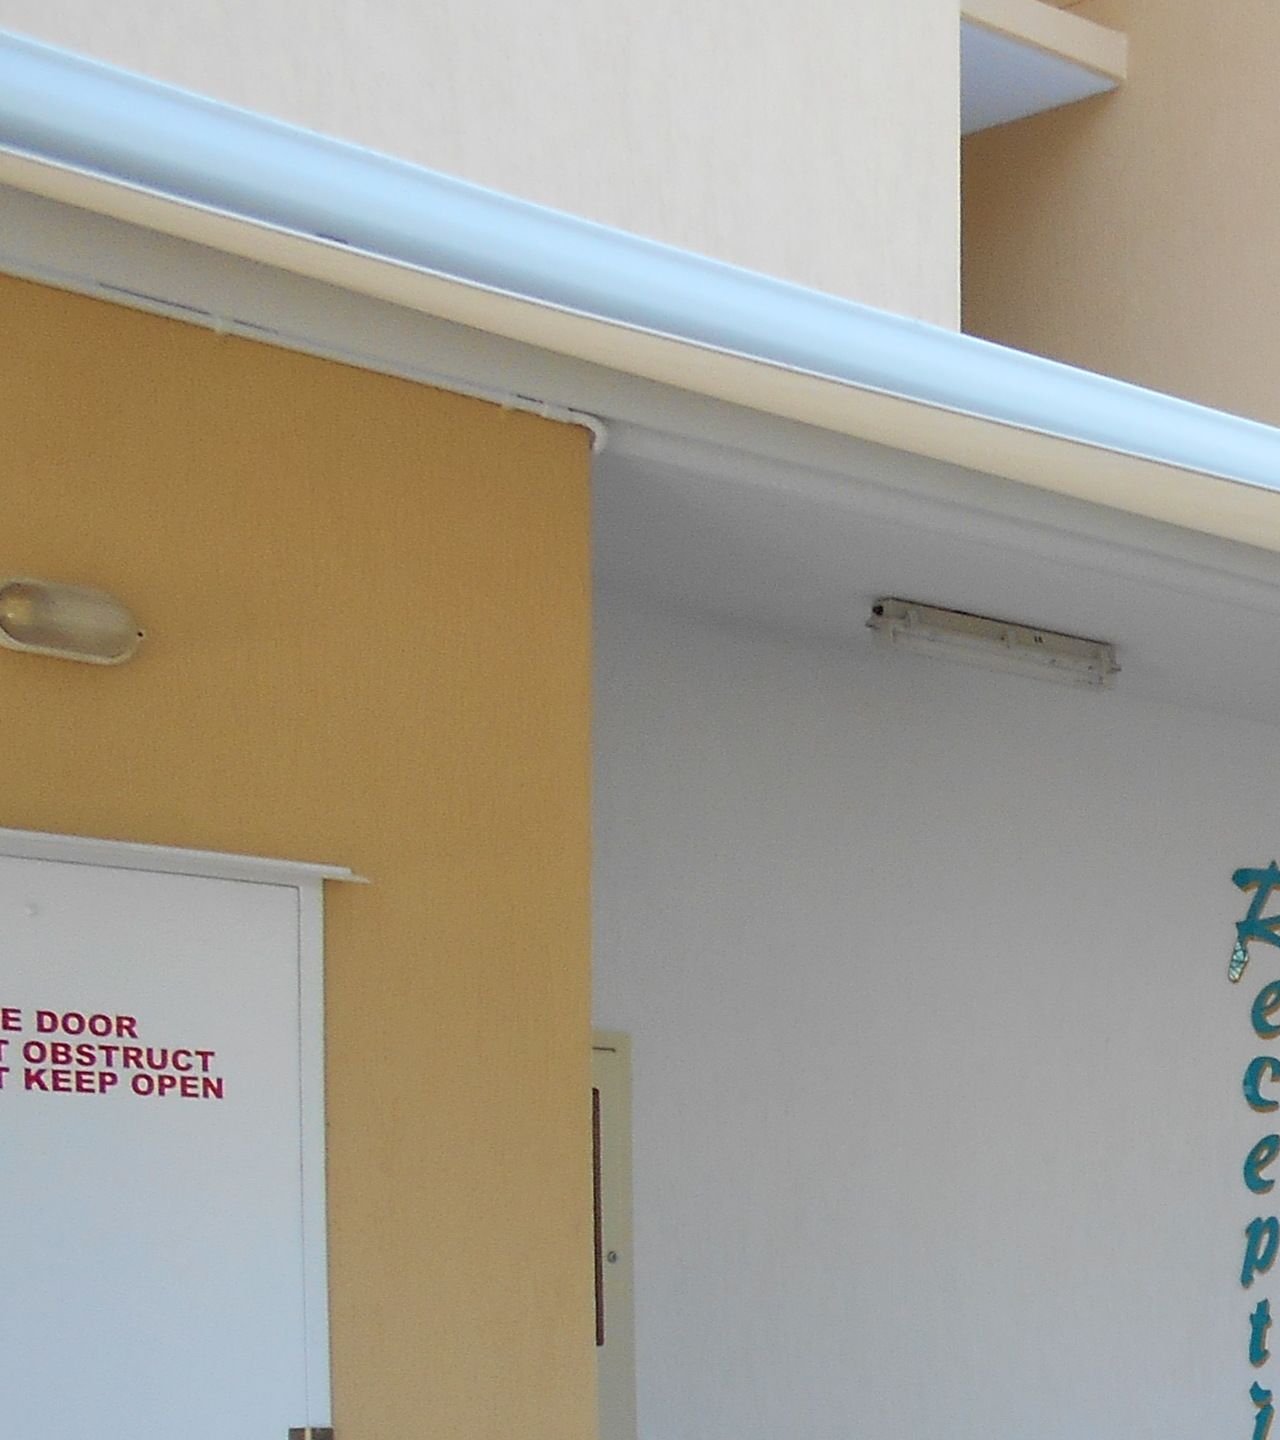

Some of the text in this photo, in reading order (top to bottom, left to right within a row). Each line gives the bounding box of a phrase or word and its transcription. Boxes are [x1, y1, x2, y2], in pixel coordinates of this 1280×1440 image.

[36, 1010, 138, 1039] DOOR
[23, 1040, 216, 1073] OBSTRUCT
[24, 1067, 118, 1094] KEEP
[131, 1073, 224, 1099] OPEN
